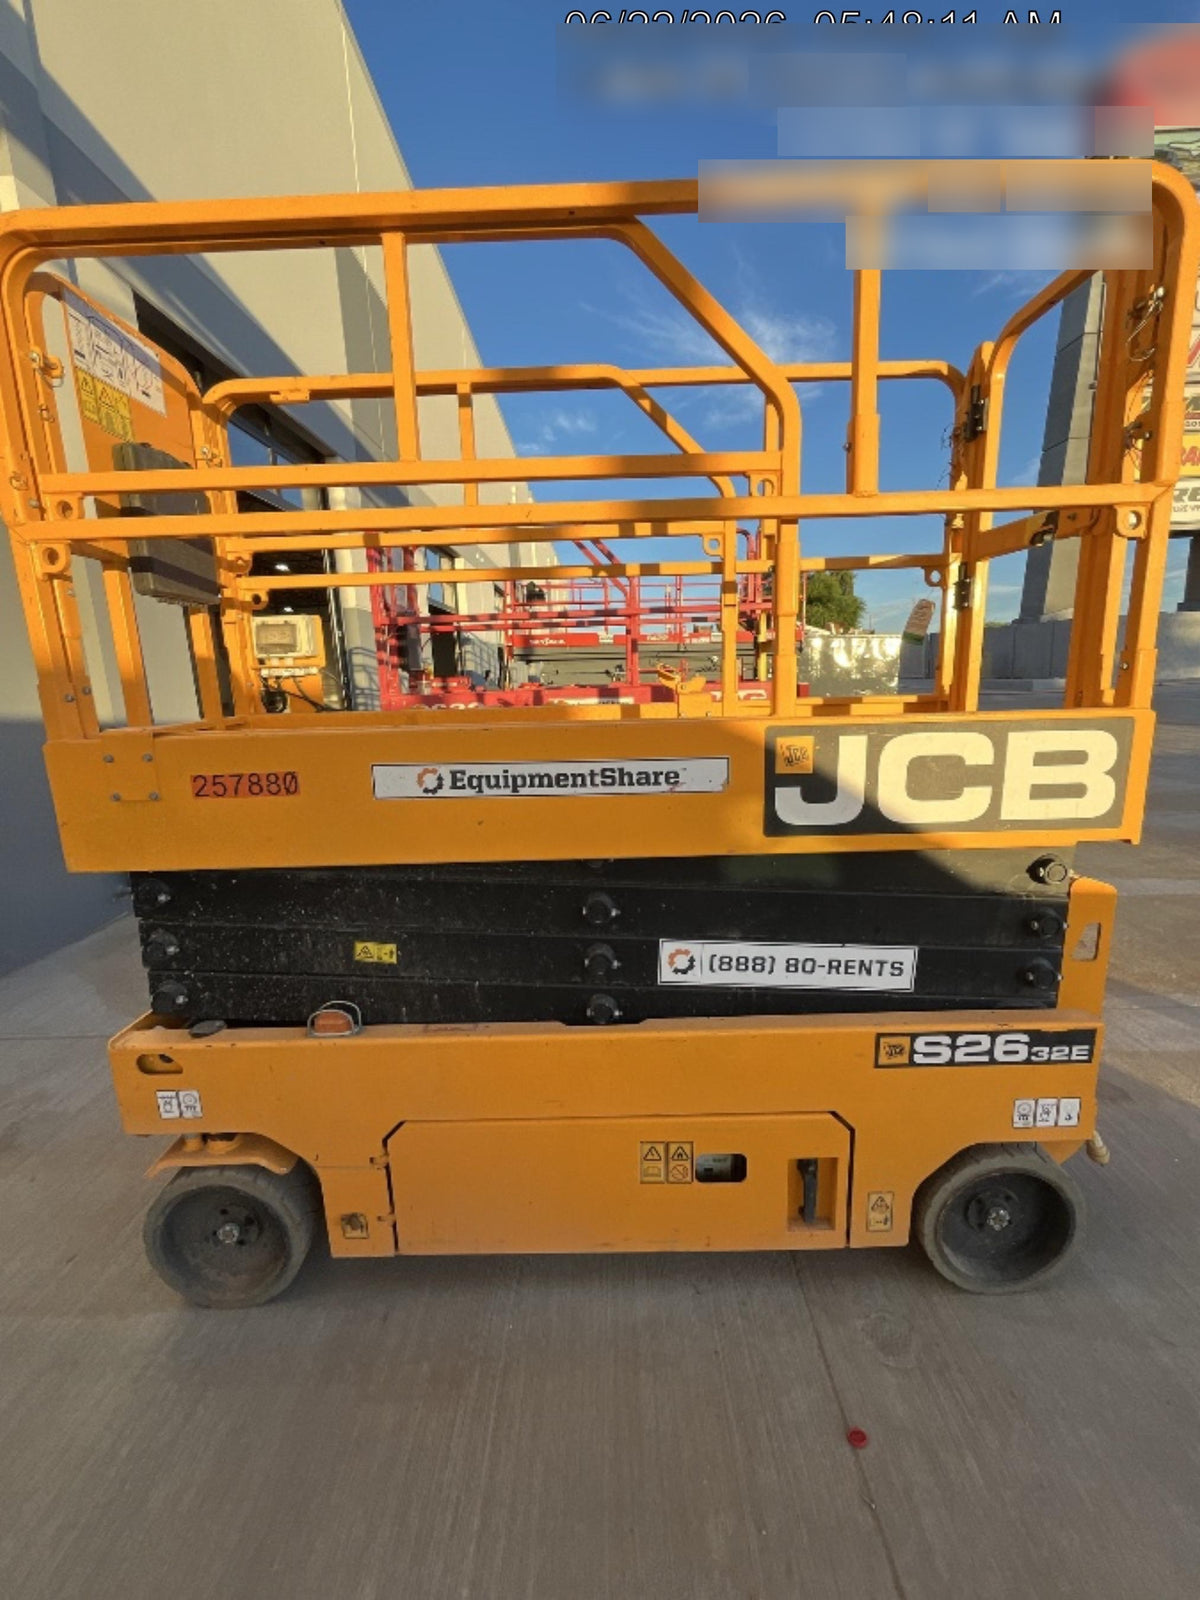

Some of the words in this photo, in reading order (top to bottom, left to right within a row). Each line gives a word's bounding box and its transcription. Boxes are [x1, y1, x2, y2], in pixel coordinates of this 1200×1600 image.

[192, 771, 298, 798] 257880
[449, 767, 680, 793] EquipmentShare
[774, 730, 1118, 826] JCB
[708, 954, 776, 975] (888)
[785, 957, 905, 978] 80-RENTS
[913, 1033, 1030, 1064] S26
[1030, 1045, 1090, 1062] 32E
